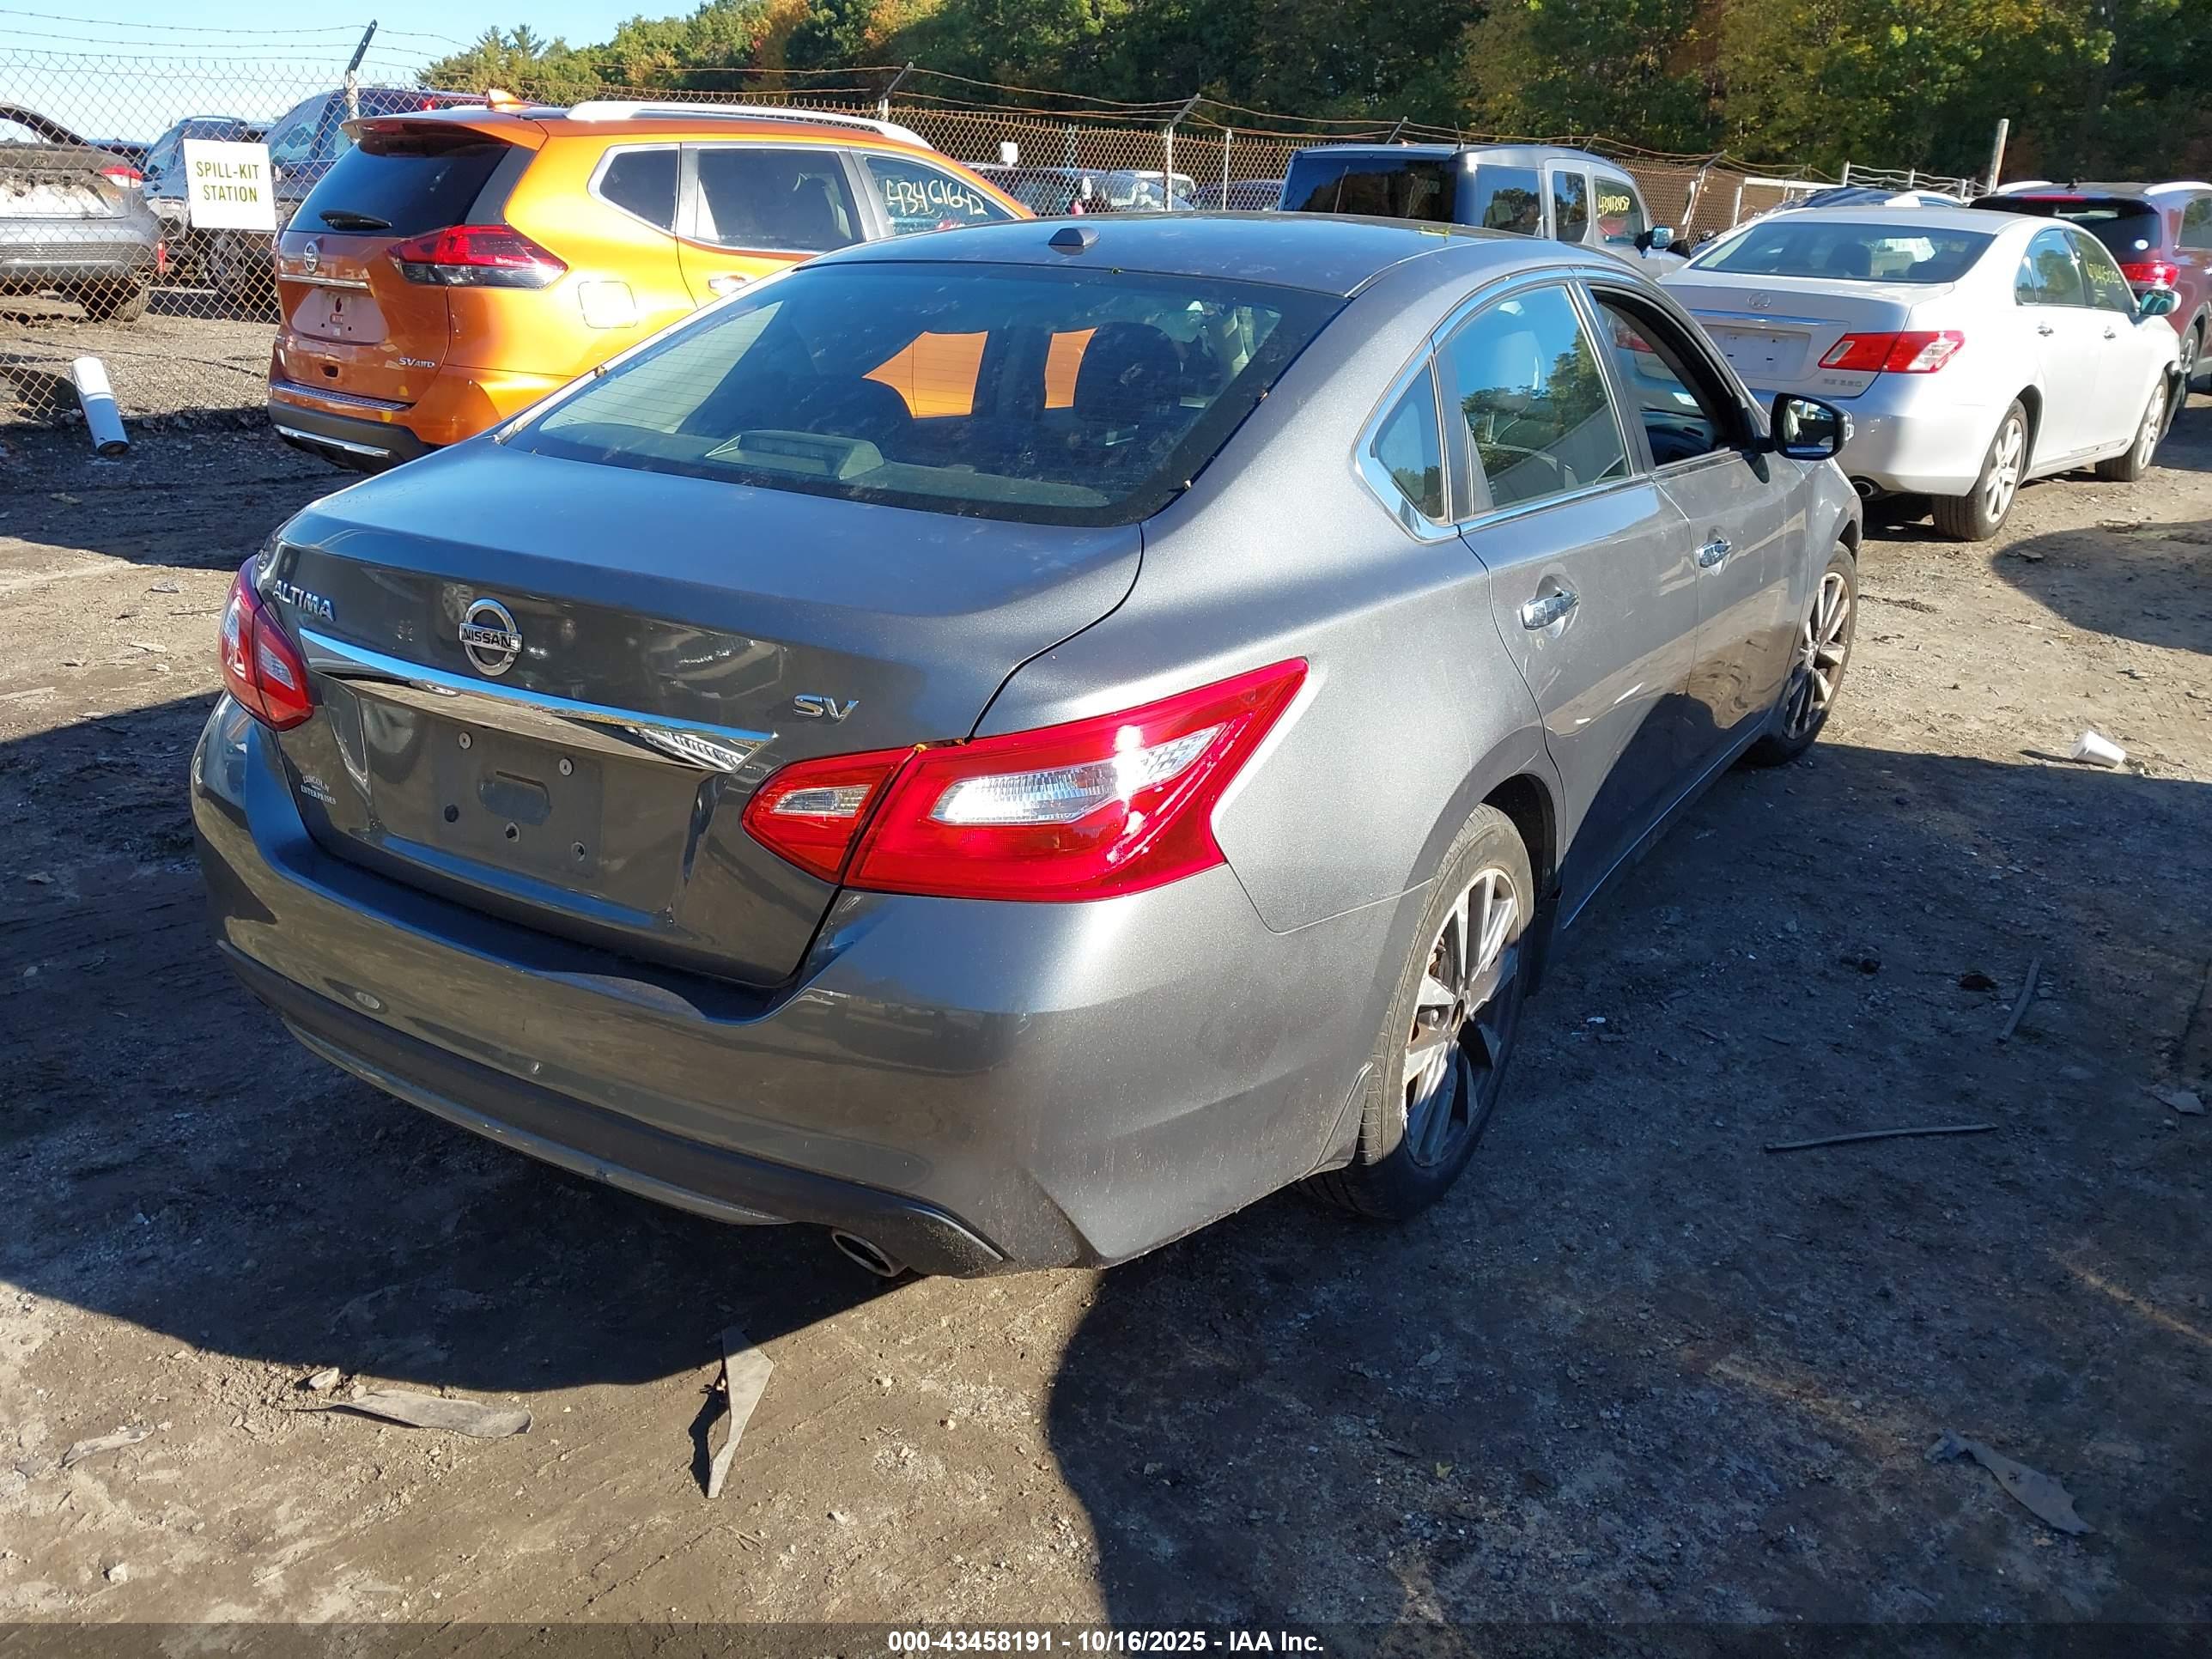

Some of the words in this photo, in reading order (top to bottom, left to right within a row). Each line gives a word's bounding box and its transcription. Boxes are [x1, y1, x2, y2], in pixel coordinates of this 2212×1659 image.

[196, 161, 259, 179] SPILL-KIT
[203, 185, 258, 203] STATION
[272, 580, 336, 623] ALTIMA
[463, 628, 512, 647] NISSAN
[793, 694, 860, 722] SV
